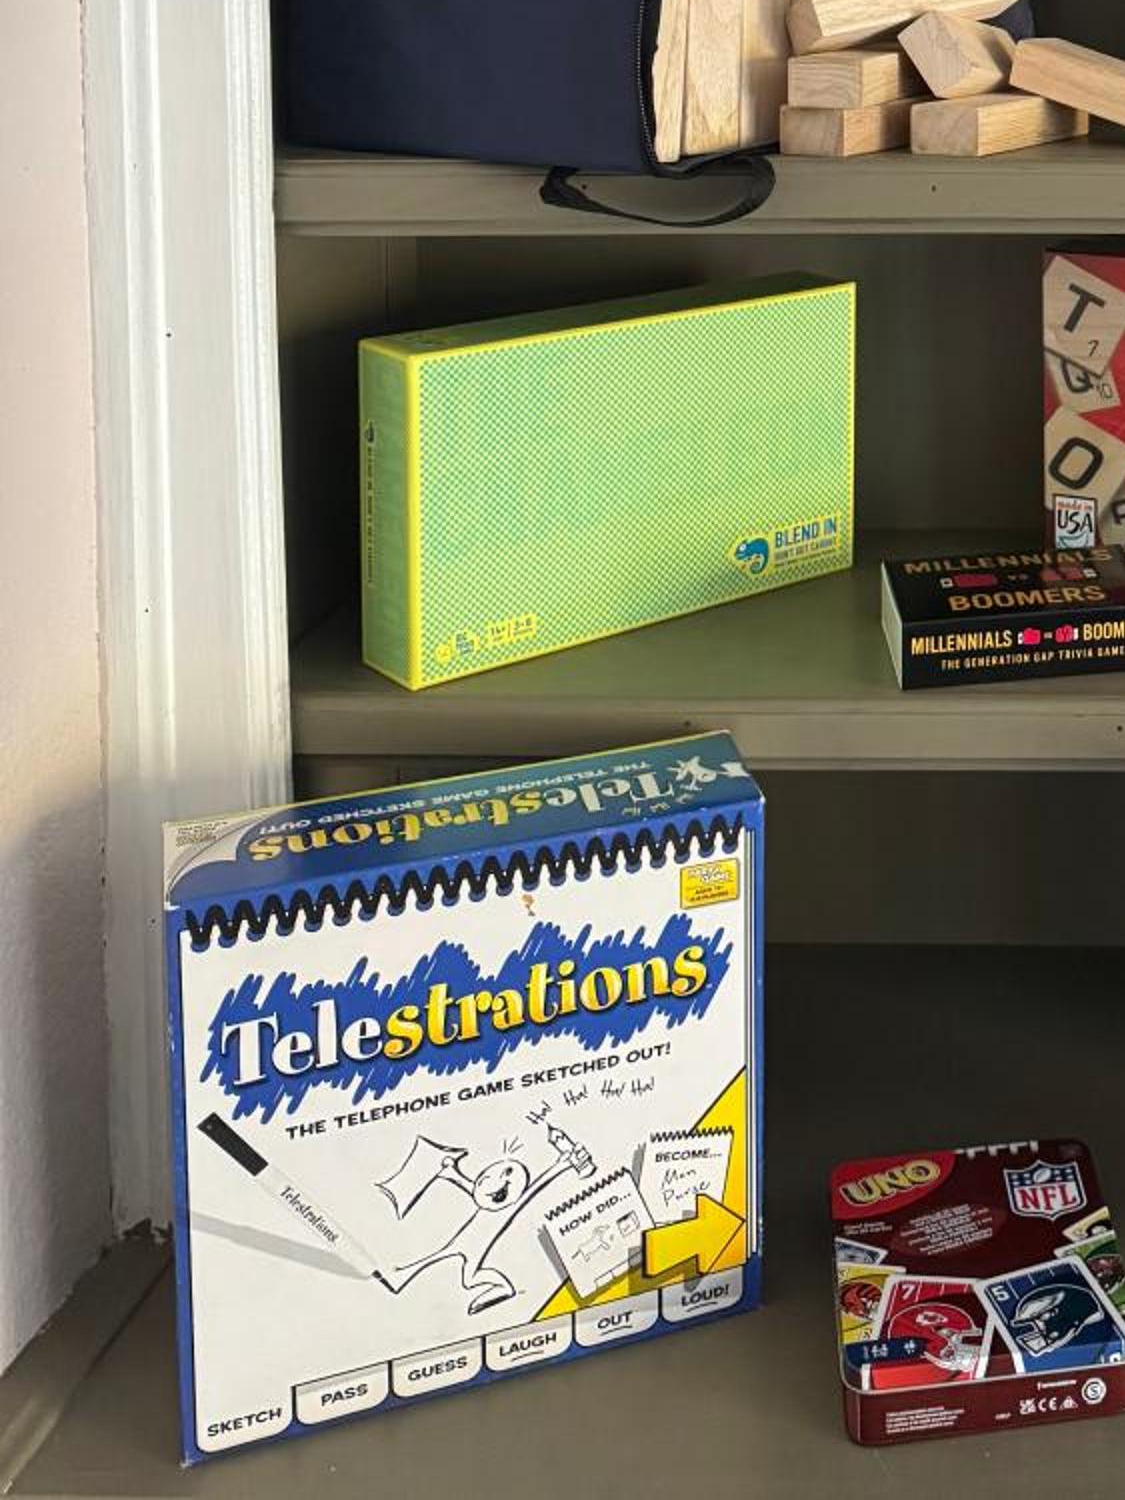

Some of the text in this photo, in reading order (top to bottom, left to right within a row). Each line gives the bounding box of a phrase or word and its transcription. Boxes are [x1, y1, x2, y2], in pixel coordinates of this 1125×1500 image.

[775, 518, 837, 549] BLEND IN
[1057, 509, 1093, 535] USA
[903, 550, 1113, 575] MILLENNIALS
[949, 585, 1106, 612] BOOMERS
[911, 629, 1013, 656] MILLENNIALS
[941, 645, 1125, 671] THE GENERATION GAP TRIVIA GAME
[612, 761, 652, 774] THE
[495, 768, 608, 794] TELEPHONE
[432, 788, 490, 804] GAME
[249, 772, 674, 862] Telestrations
[317, 799, 426, 824] SKETCHED
[220, 944, 708, 1088] Telestrations
[286, 1041, 672, 1141] THE TELEPHONE GAME SKETCHED OUT!
[660, 1181, 711, 1207] Purse
[840, 1159, 942, 1206] UNO
[1018, 1183, 1078, 1211] NFL
[280, 1185, 340, 1243] Telestrations
[559, 1211, 593, 1237] HOW
[681, 1284, 731, 1307] LOUD!
[901, 1283, 917, 1300] 7
[990, 1285, 1012, 1301] 5
[597, 1311, 633, 1329] OUT
[499, 1332, 558, 1357] LAUGH
[407, 1356, 469, 1381] GUESS
[320, 1383, 369, 1407] PASS
[207, 1406, 283, 1437] SKETCH
